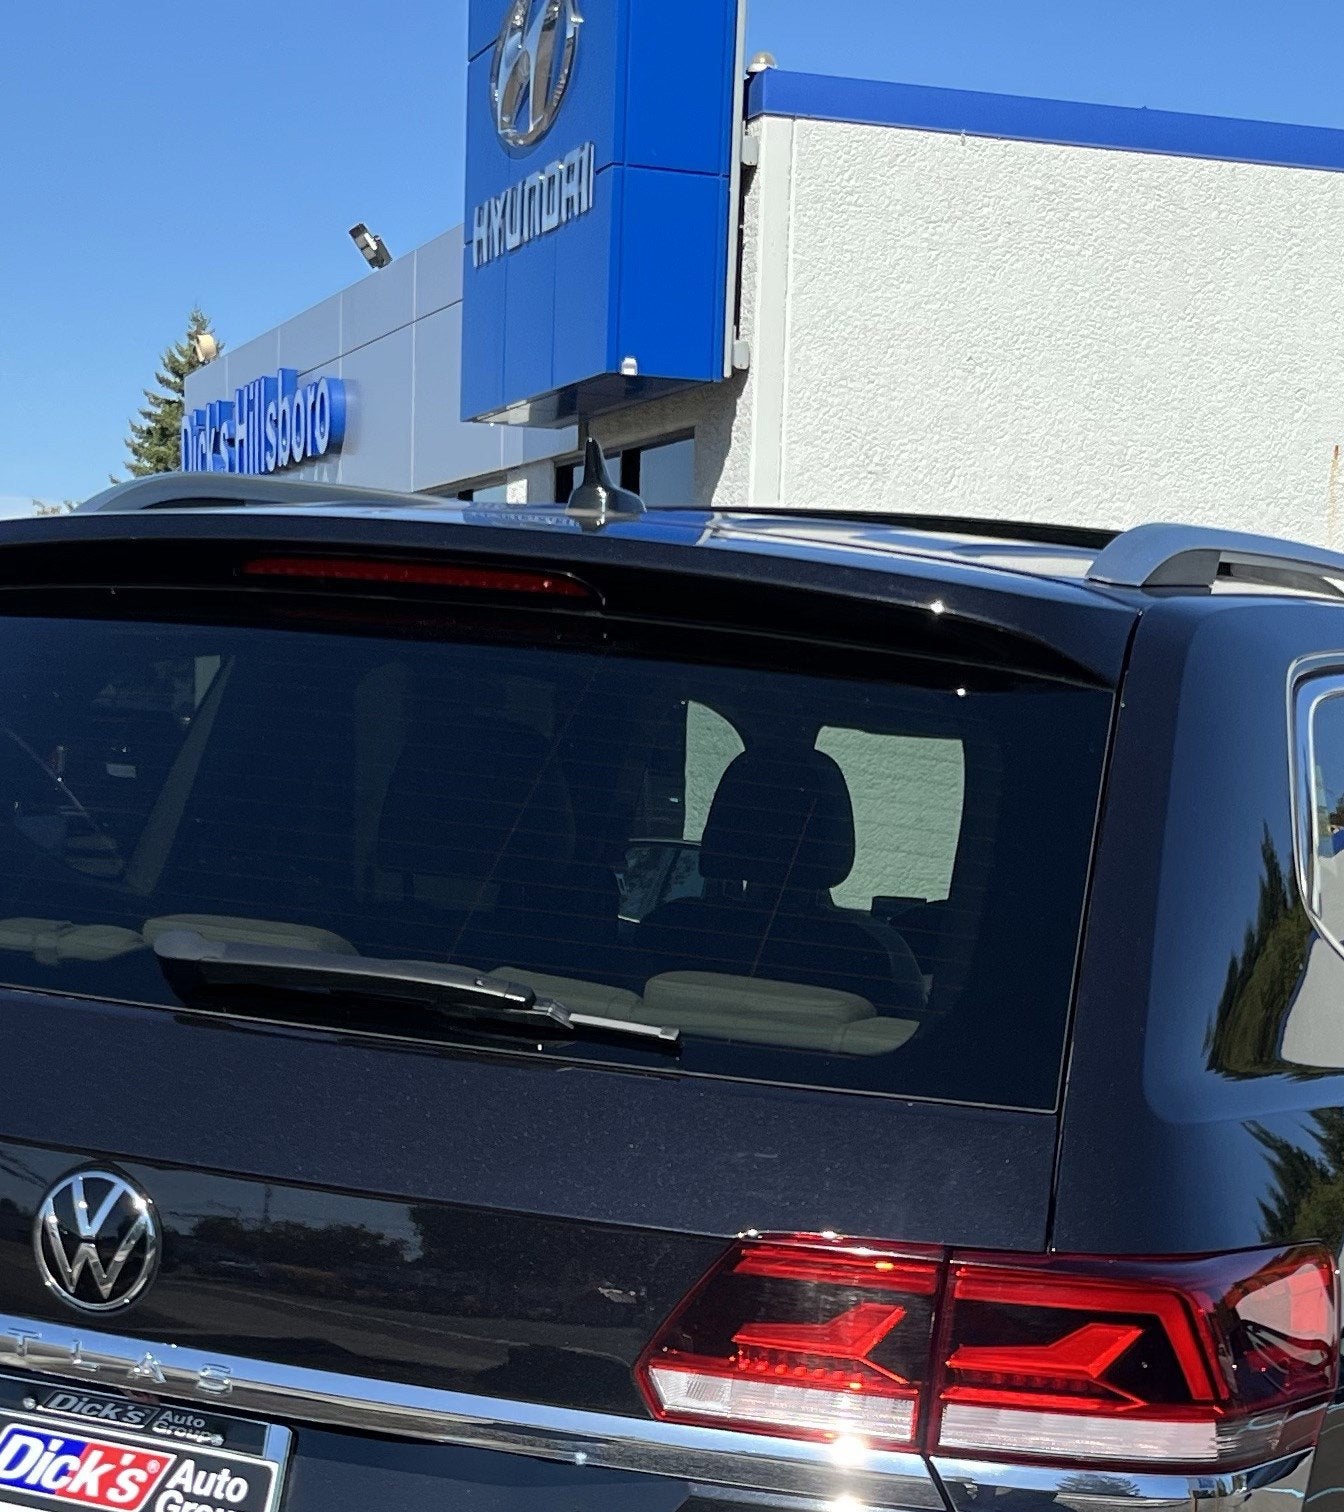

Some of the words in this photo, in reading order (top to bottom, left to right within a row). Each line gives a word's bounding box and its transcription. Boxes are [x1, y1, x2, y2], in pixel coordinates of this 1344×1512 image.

[472, 141, 594, 268] HYUNDAI
[235, 368, 337, 474] Hillsboro
[47, 1392, 147, 1425] Dick's
[158, 1410, 206, 1429] Auto
[165, 1459, 249, 1503] Auto
